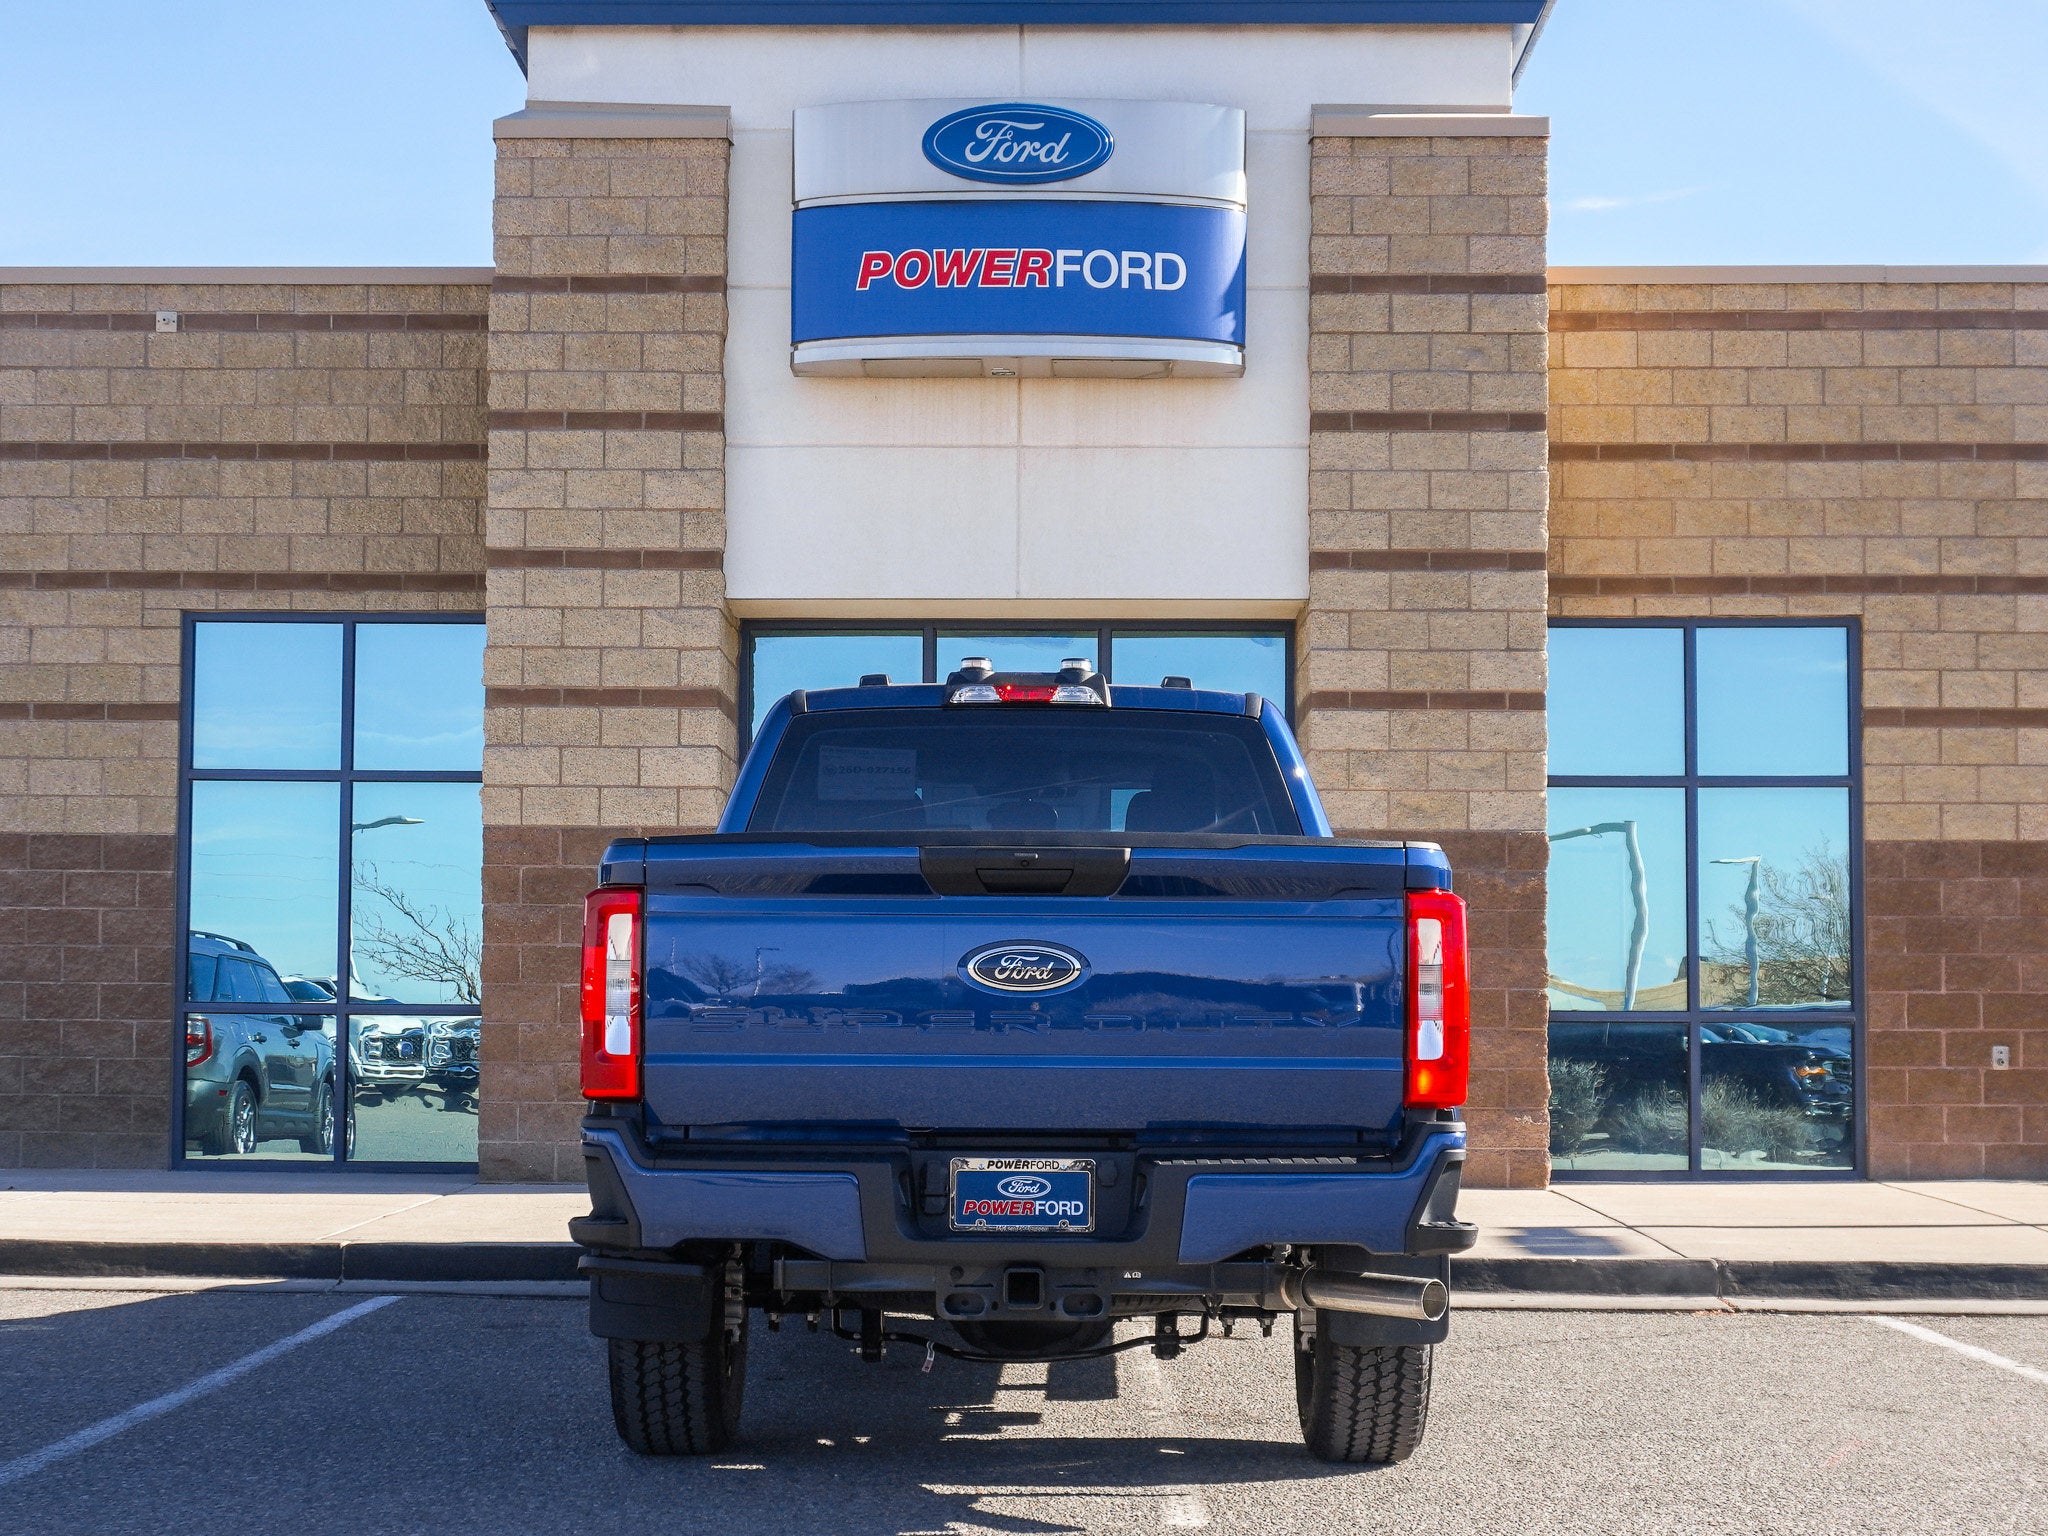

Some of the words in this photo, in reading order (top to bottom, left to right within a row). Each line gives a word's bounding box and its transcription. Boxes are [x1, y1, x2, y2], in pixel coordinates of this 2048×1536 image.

[964, 120, 1072, 164] Ford
[855, 248, 1187, 291] POWERFORD
[994, 954, 1055, 980] Ford
[689, 1007, 1051, 1035] SUPER
[1083, 1009, 1361, 1037] DUTY
[986, 1159, 1060, 1170] POWERFORD
[1008, 1179, 1040, 1194] Ford
[962, 1200, 1084, 1216] POWERFORD
